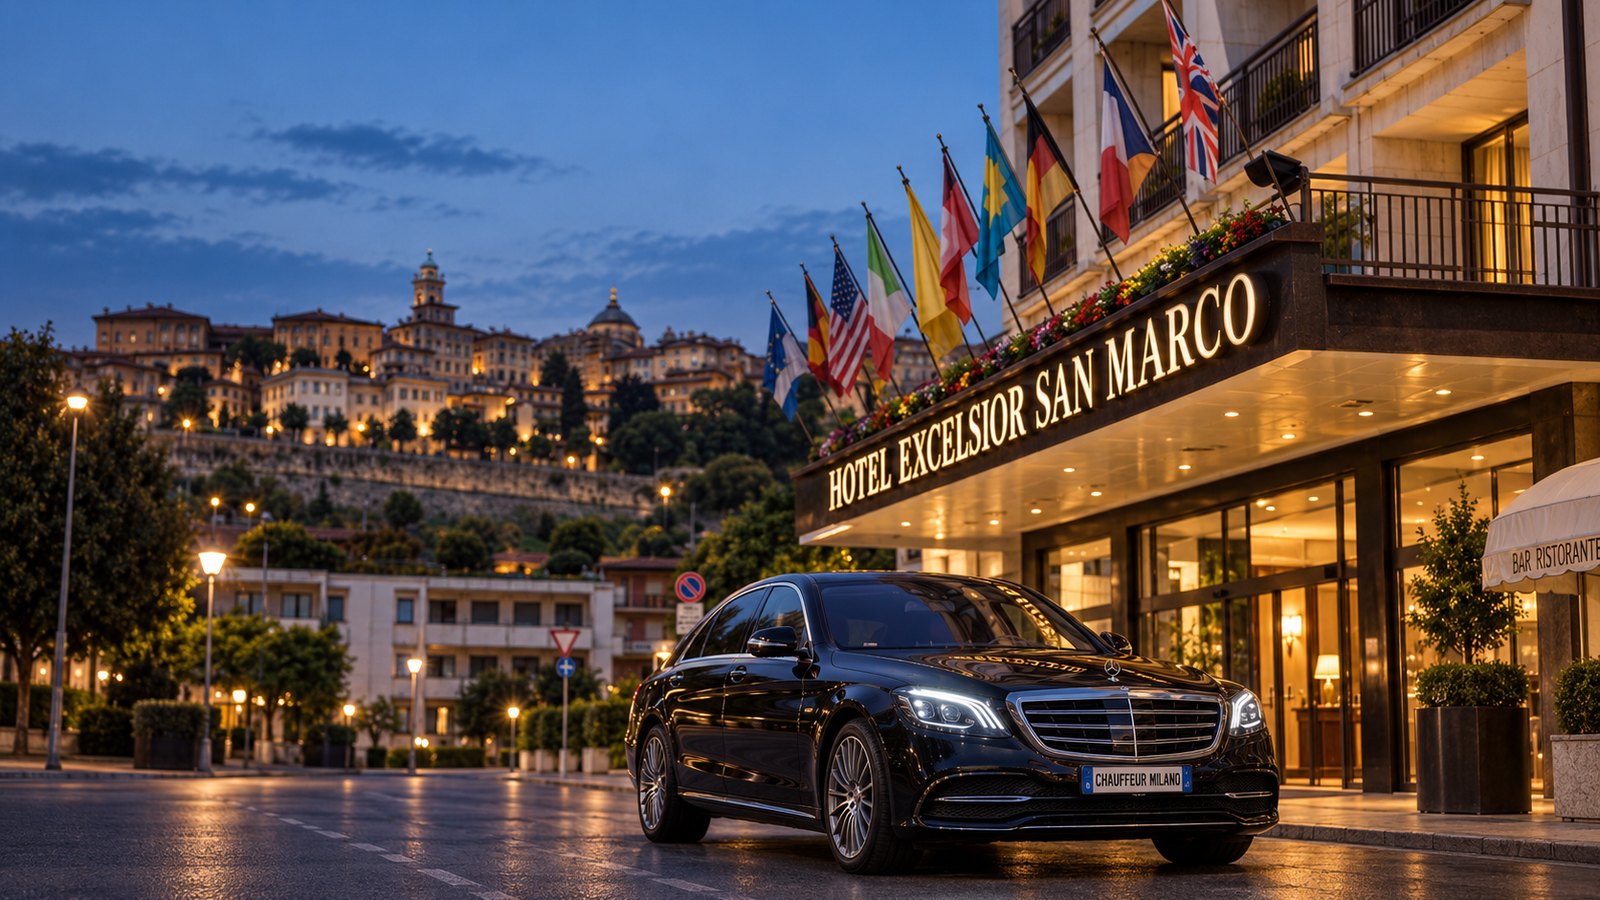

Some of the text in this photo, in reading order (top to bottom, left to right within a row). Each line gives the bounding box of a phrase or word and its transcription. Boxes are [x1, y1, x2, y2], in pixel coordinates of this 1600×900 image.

[828, 272, 1257, 511] HOTEL EXCELSIOR SAN MARCO
[1512, 549, 1532, 574] BAR
[1095, 773, 1147, 787] CHAUFFEUR
[1149, 772, 1181, 787] MILANO
